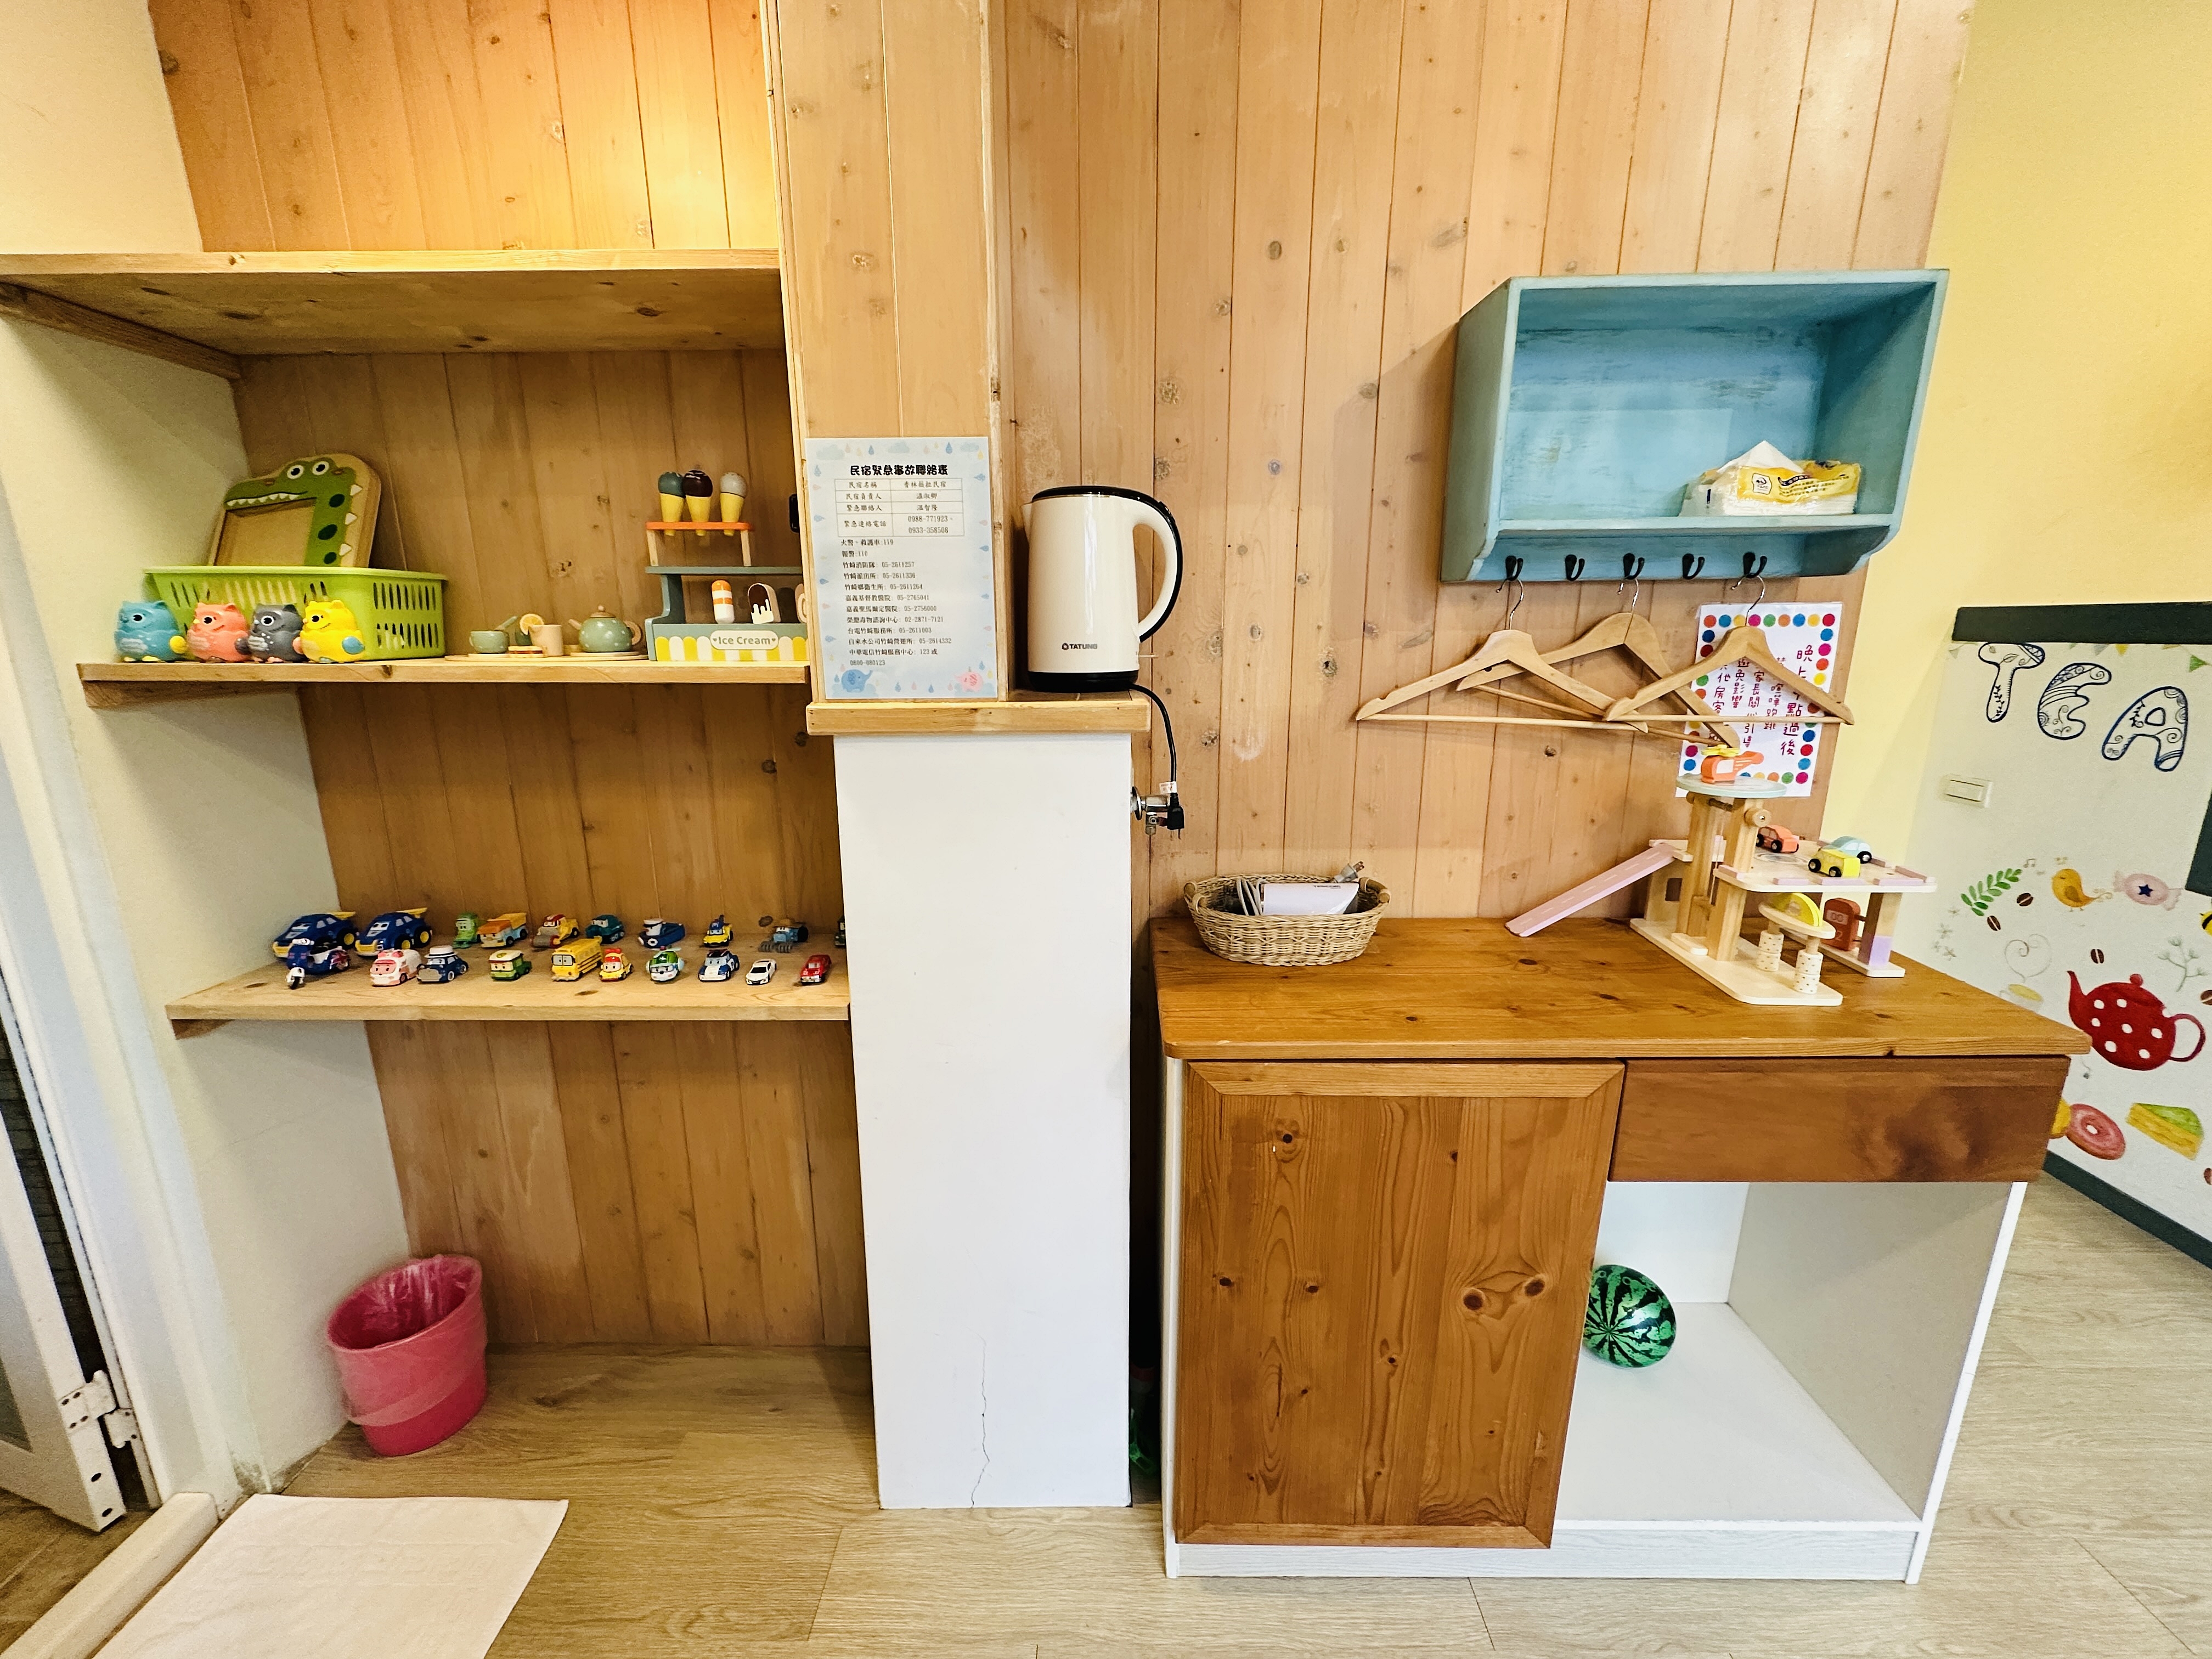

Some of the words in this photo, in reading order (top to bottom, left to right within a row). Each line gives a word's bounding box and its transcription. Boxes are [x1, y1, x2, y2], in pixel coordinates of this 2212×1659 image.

[850, 464, 948, 476] 民宿緊急事故聯絡表
[719, 636, 733, 645] Ice
[737, 636, 771, 645] Cream
[1781, 645, 1813, 756] 晚上點過後
[1978, 642, 2188, 771] TEA
